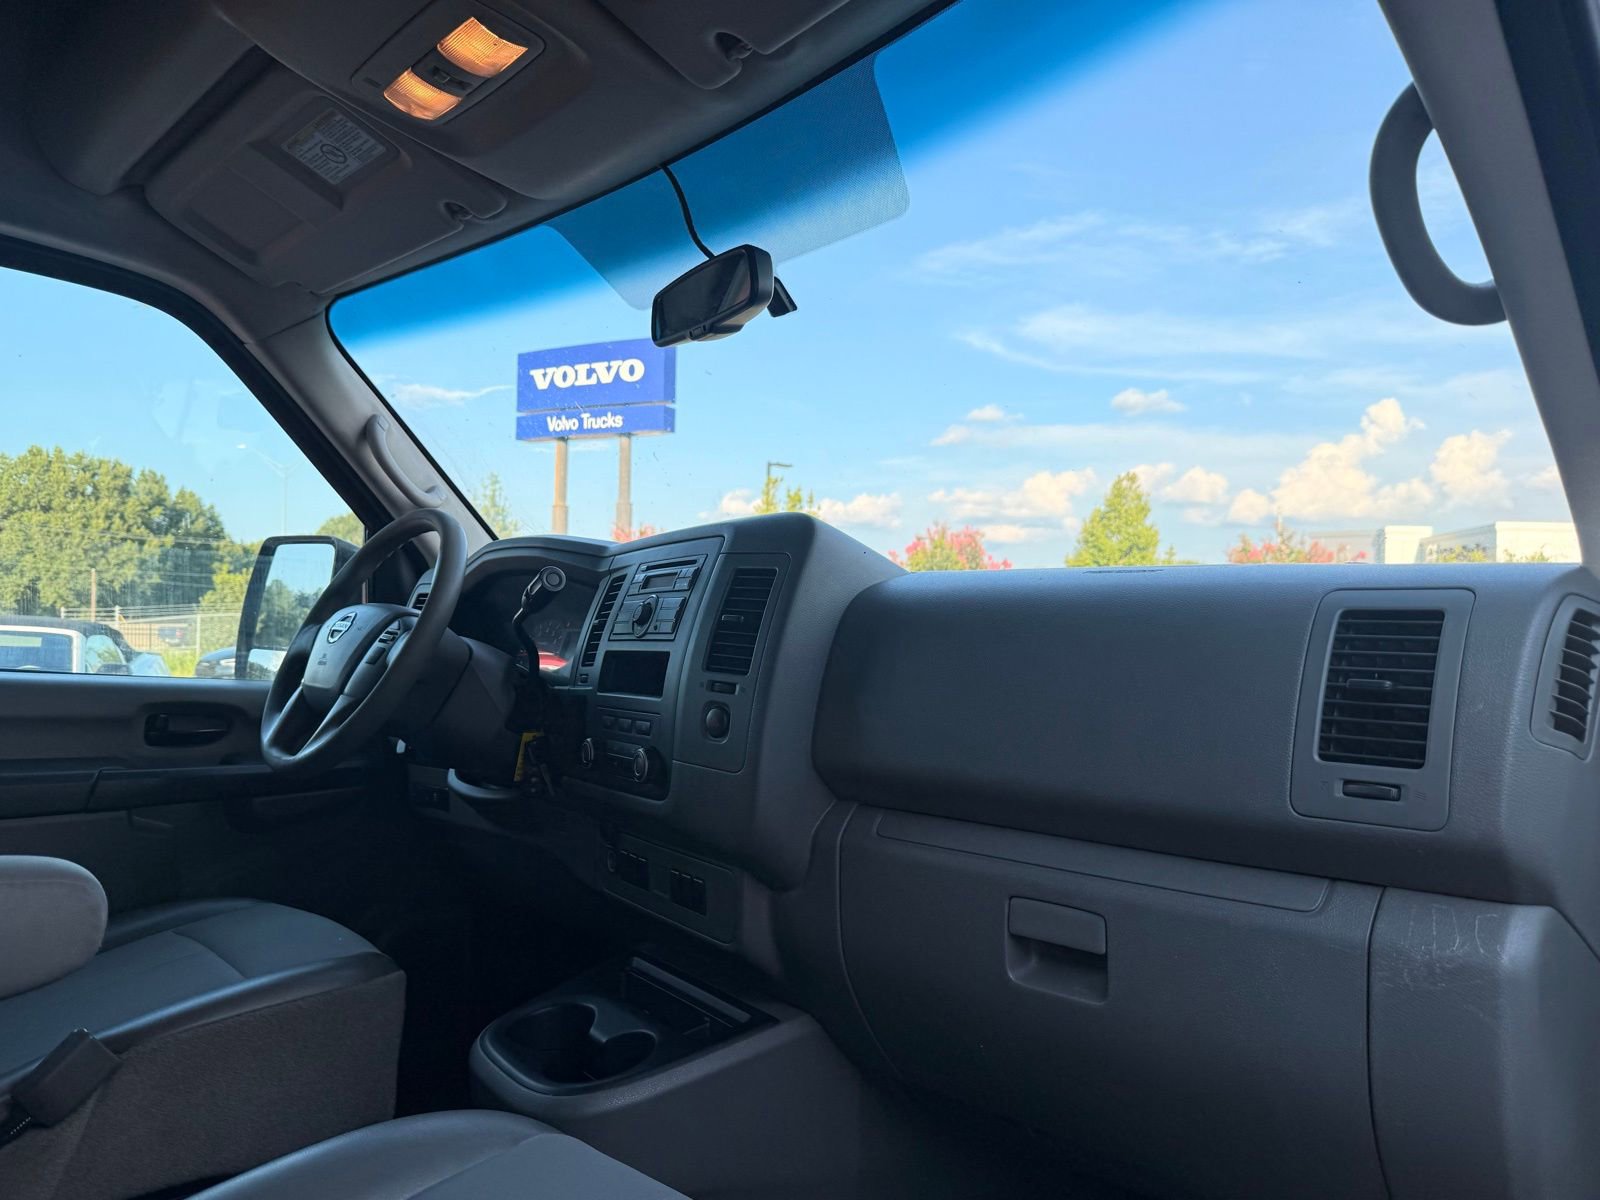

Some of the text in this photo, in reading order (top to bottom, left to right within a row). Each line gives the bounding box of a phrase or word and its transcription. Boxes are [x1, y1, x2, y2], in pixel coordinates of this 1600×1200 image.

[529, 358, 645, 390] VOLVO
[546, 412, 623, 432] Volvo Trucks
